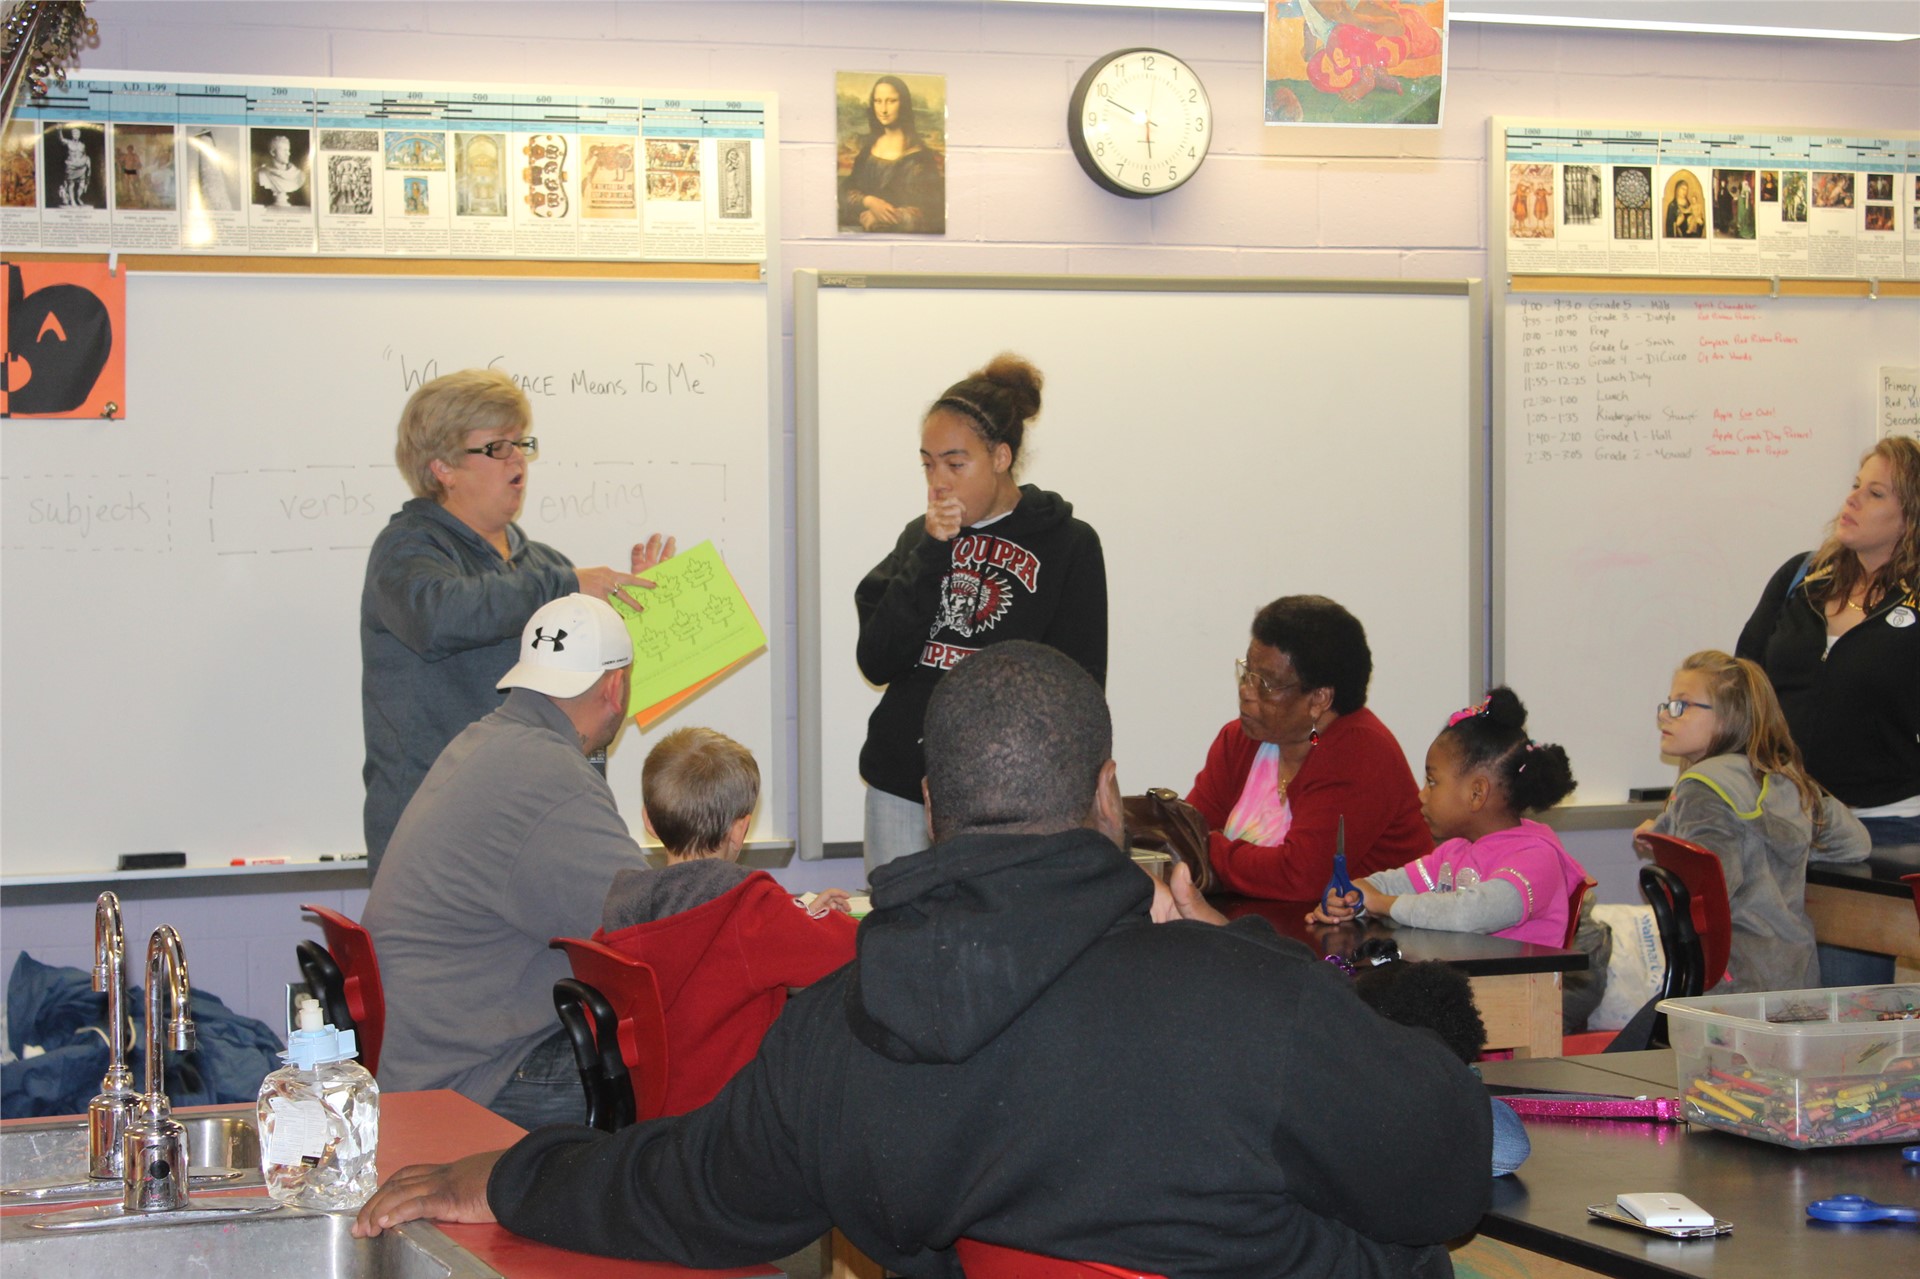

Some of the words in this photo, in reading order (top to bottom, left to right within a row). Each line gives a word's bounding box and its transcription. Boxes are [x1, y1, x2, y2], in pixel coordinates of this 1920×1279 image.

[1114, 63, 1125, 77] 11
[1141, 56, 1155, 71] 12
[1172, 66, 1178, 80] 1
[121, 83, 142, 91] A.D.
[147, 84, 167, 92] 1-99
[204, 86, 221, 94] 100
[271, 87, 288, 96] 200
[340, 90, 357, 98] 300
[1096, 82, 1109, 97] 10
[407, 92, 423, 100] 400
[472, 94, 488, 102] 500
[536, 95, 552, 103] 600
[600, 97, 615, 105] 700
[1188, 88, 1197, 103] 2
[664, 100, 680, 108] 800
[726, 102, 742, 110] 900
[1088, 112, 1097, 127] 9
[1195, 117, 1204, 132] 3
[1523, 128, 1541, 136] 1000
[1625, 131, 1642, 139] 1200
[1678, 132, 1695, 140] 1300
[1728, 134, 1744, 142] 1400
[1776, 135, 1793, 143] 1500
[1826, 137, 1842, 145] 1600
[1873, 139, 1890, 147] 1700
[1096, 142, 1105, 157] 8
[1187, 146, 1196, 160] 4
[1116, 163, 1124, 177] 7
[1168, 166, 1178, 181] 5
[1142, 172, 1151, 187] 6
[1588, 297, 1620, 310] Grade
[1623, 299, 1632, 310] 5
[1588, 311, 1617, 323] Grade
[1623, 313, 1630, 322] 3
[1590, 325, 1609, 338] Prep
[1589, 341, 1616, 352] Grade
[1588, 354, 1616, 367] Grade
[1619, 355, 1628, 365] 4
[571, 369, 627, 395] Means
[634, 362, 658, 393] To
[1597, 371, 1627, 384] Lunch
[1884, 376, 1917, 399] Primary
[1596, 390, 1629, 402] Lunch
[1596, 405, 1652, 427] Kindergarten
[1595, 428, 1629, 443] Grade
[1595, 447, 1627, 461] Grade
[28, 491, 151, 538] subjects
[279, 480, 376, 520] verbs
[539, 480, 648, 527] ending
[952, 534, 1041, 593] QUIPPA
